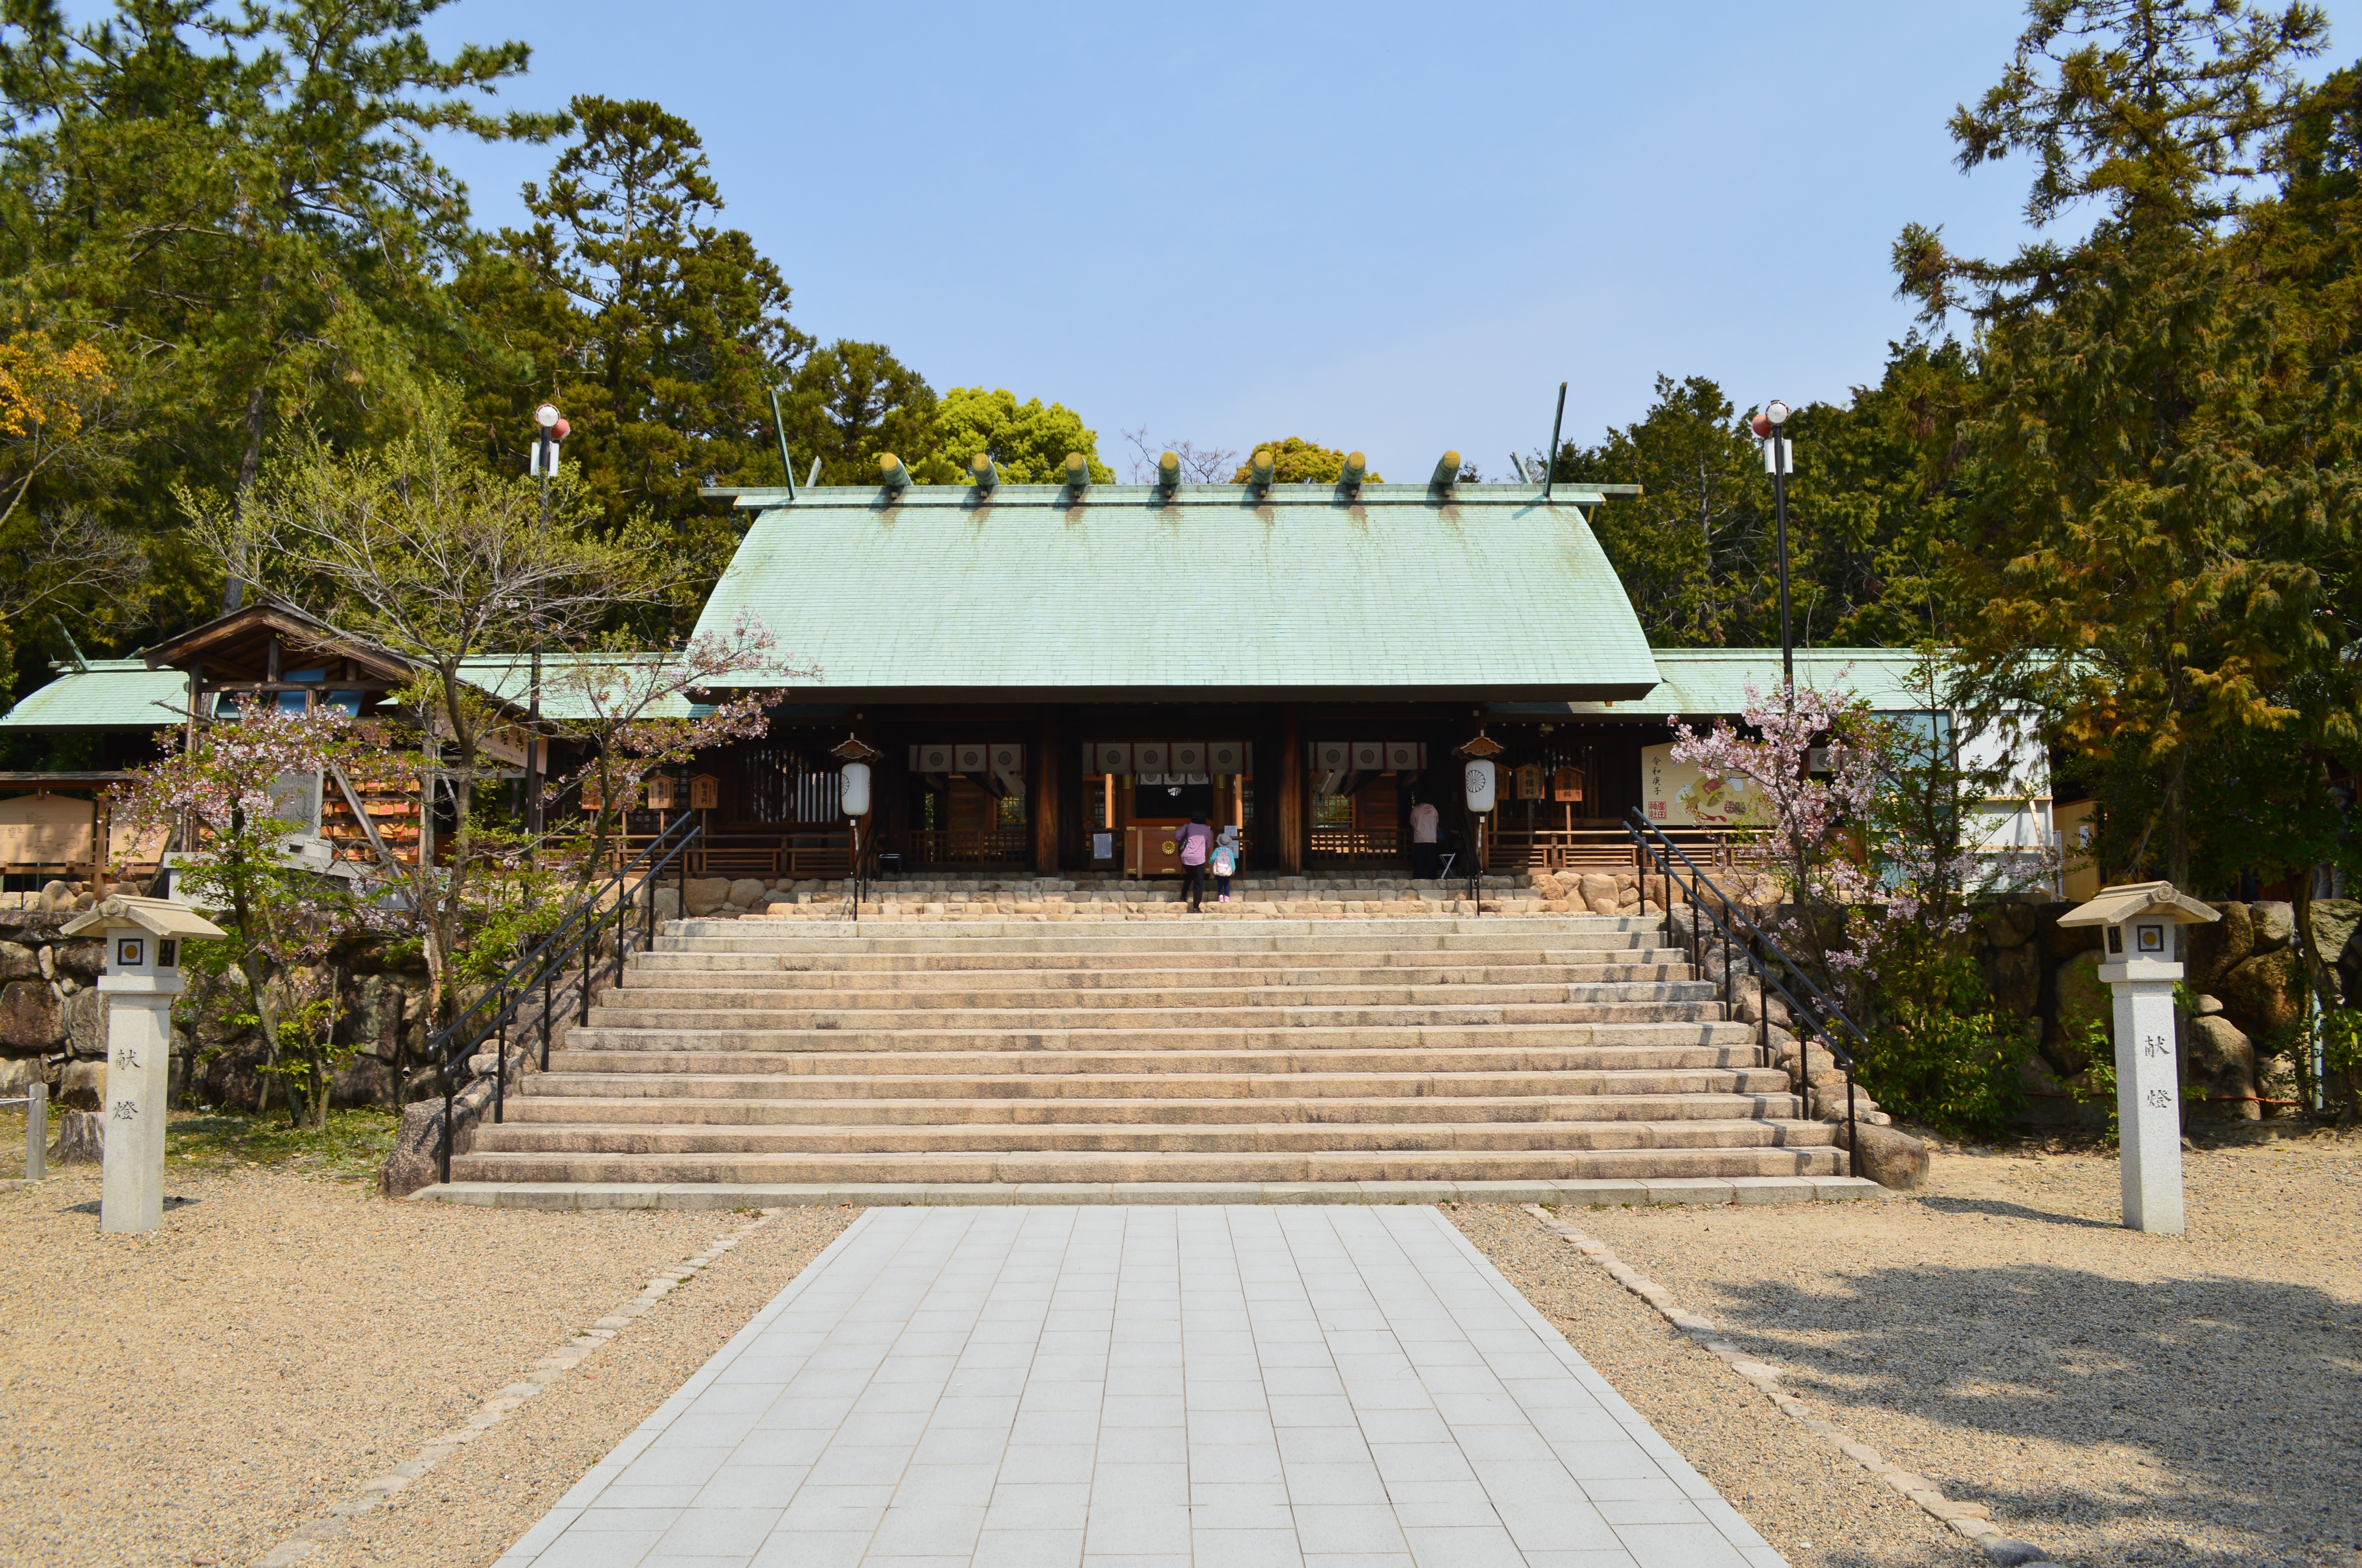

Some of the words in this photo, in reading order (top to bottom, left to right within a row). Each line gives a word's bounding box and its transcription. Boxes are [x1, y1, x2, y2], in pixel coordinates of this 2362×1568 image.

[1652, 756, 1661, 795] 令和庚子
[112, 1049, 141, 1120] 献燈
[2145, 1035, 2173, 1108] 献燈
